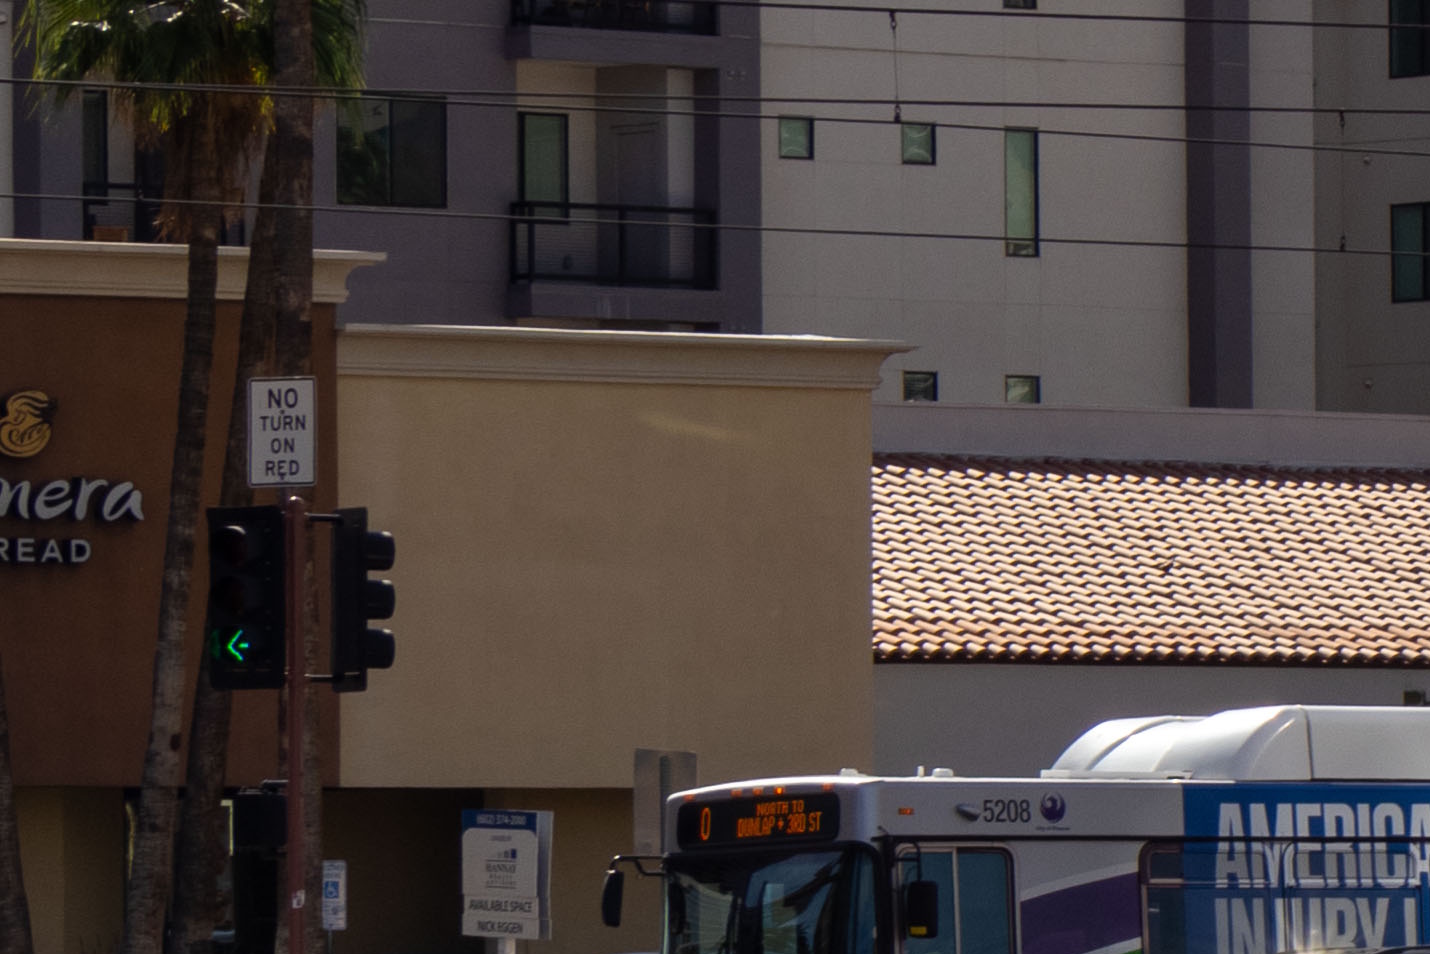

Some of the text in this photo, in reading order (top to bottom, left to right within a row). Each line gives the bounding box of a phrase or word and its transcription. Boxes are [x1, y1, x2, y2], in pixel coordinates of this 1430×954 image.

[268, 388, 298, 408] NO
[259, 415, 306, 431] TURN
[271, 438, 295, 454] ON
[265, 460, 300, 476] RED
[755, 799, 805, 816] NORTH TO
[983, 799, 1031, 823] 5208
[736, 816, 775, 838] DUNLAP
[786, 813, 806, 834] 3RD
[808, 811, 823, 832] ST
[469, 899, 533, 913] AVAILABLE SPACE
